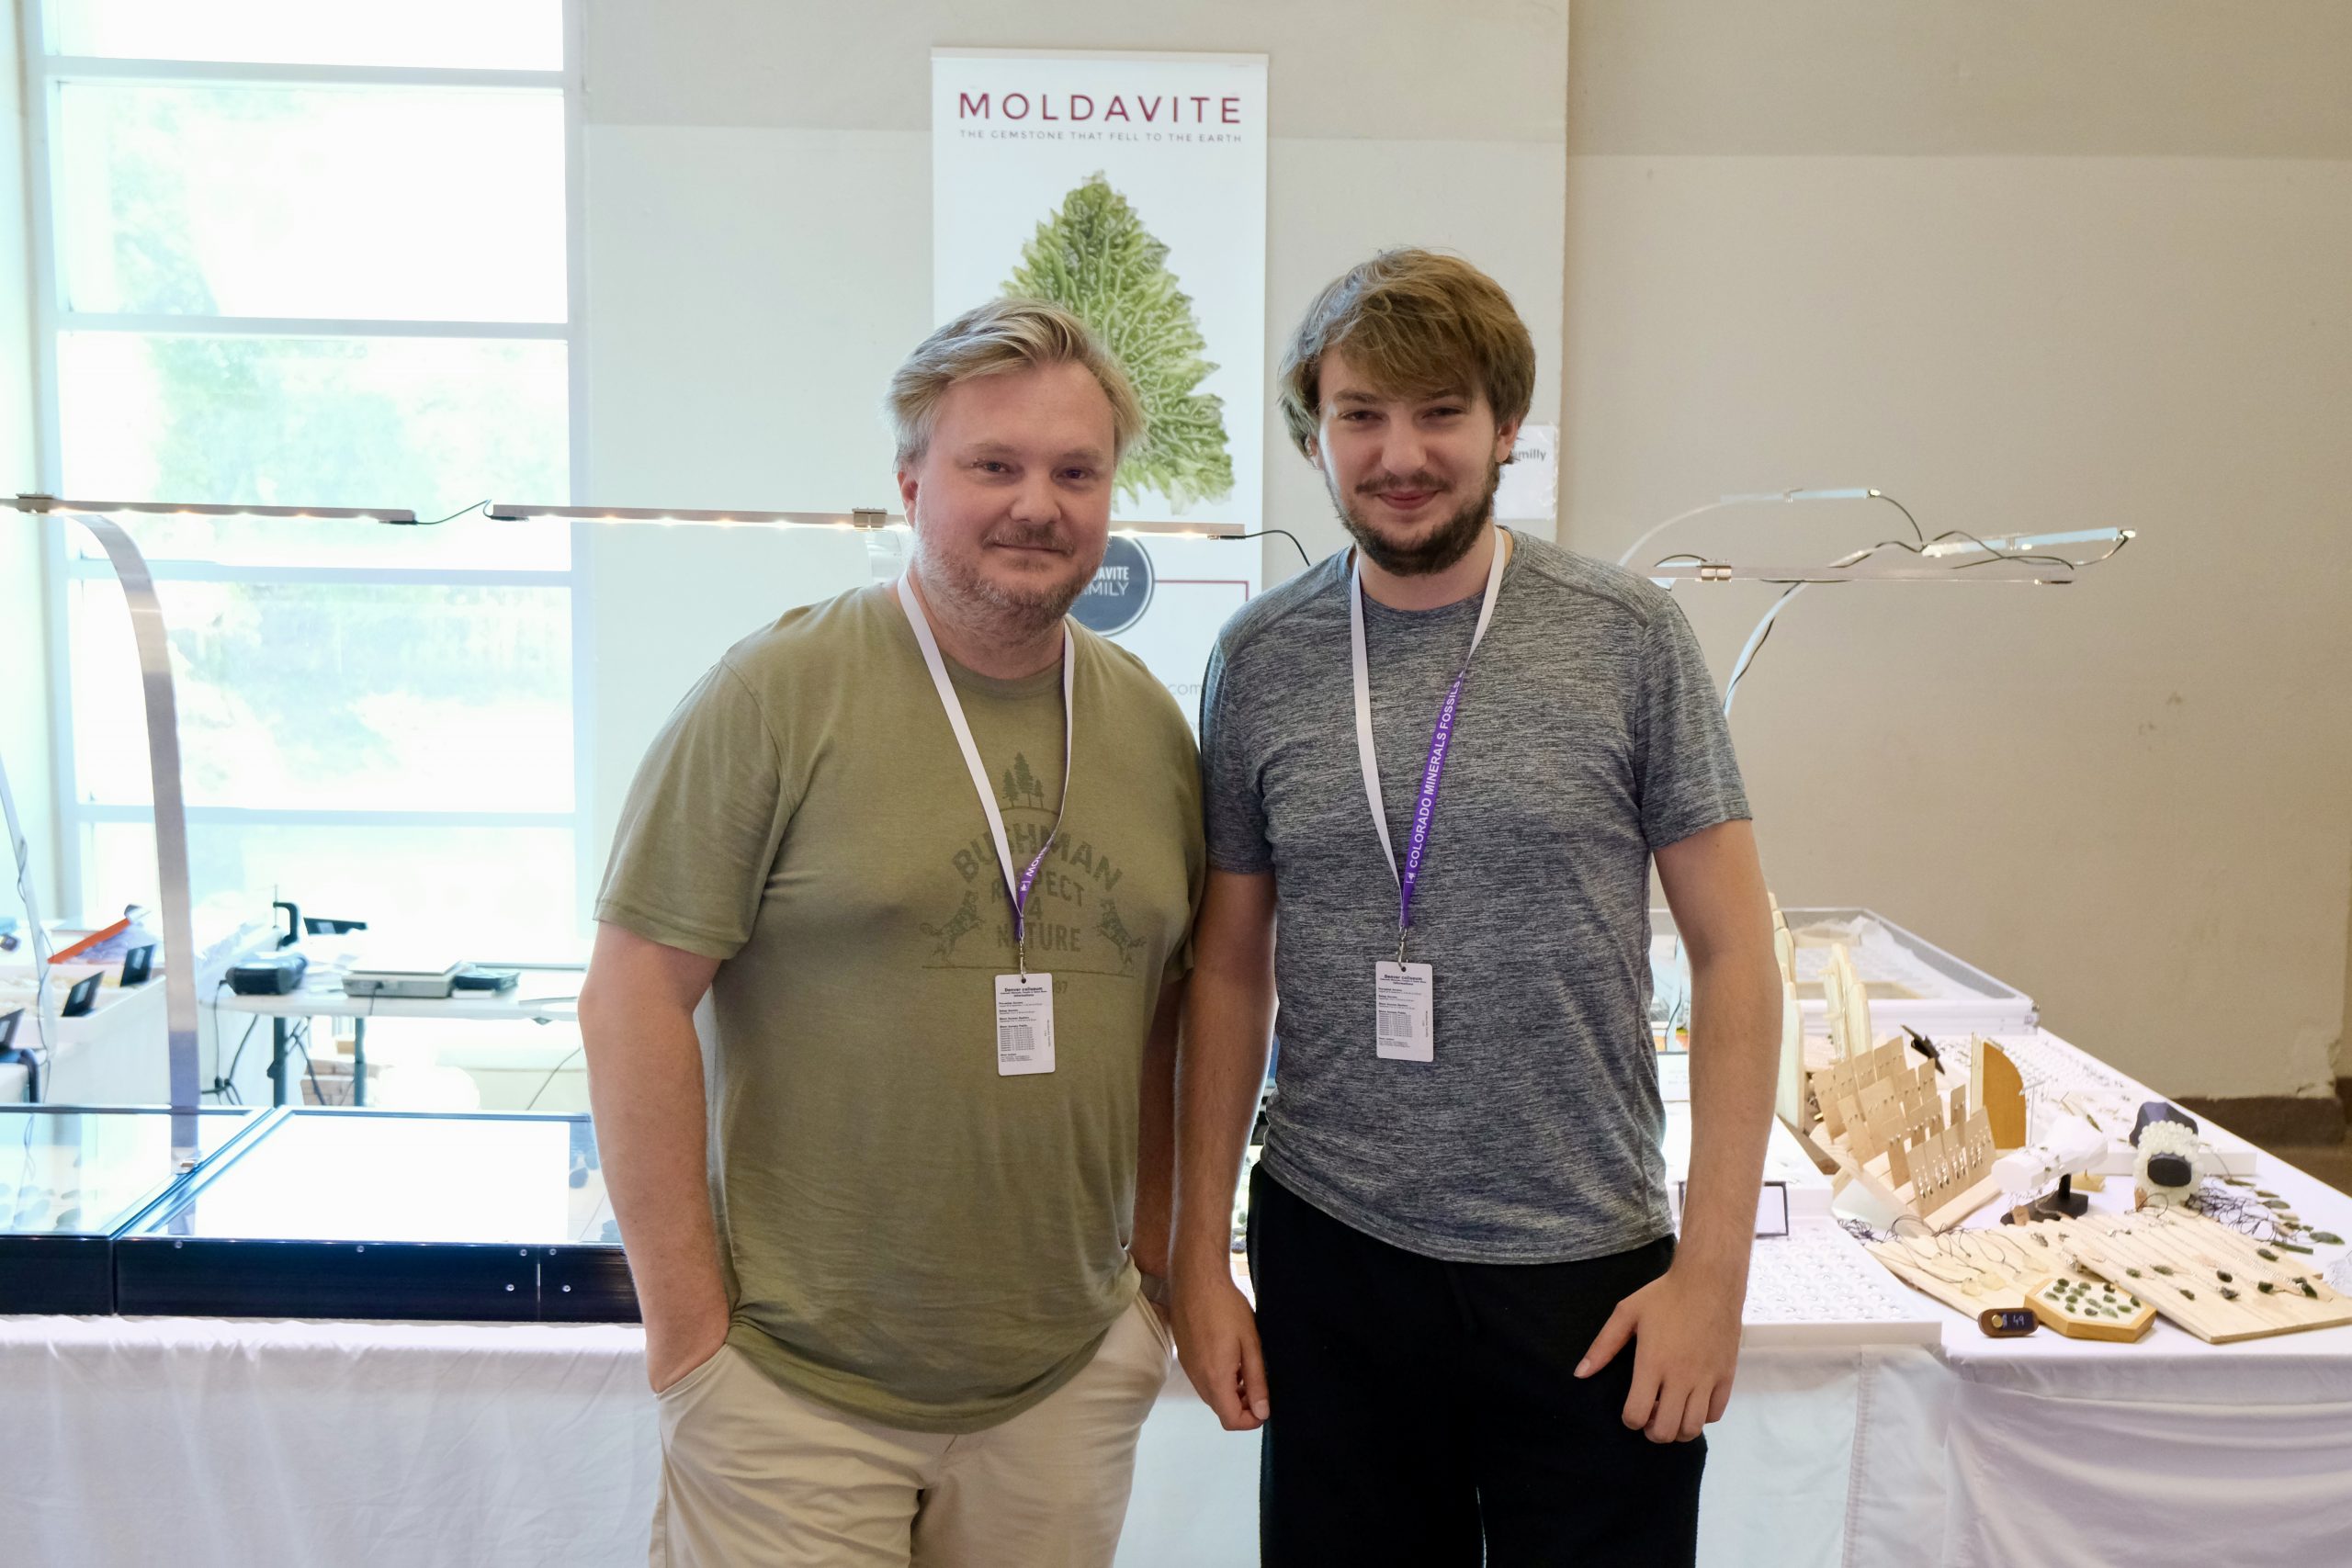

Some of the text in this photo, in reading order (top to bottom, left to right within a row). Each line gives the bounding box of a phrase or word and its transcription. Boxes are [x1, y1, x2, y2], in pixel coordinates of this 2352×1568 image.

[960, 93, 1240, 123] MOLDAVITE
[960, 130, 1241, 142] THE GEMSTONE THAT FELL TO THE EARTH
[1093, 566, 1130, 581] AVITE
[1409, 681, 1461, 868] COLORADO MINERALS FOSSILS
[952, 823, 1123, 892] BUHMAN
[991, 868, 1084, 907] RPECT
[1028, 896, 1043, 920] A
[997, 921, 1081, 953] NTURE
